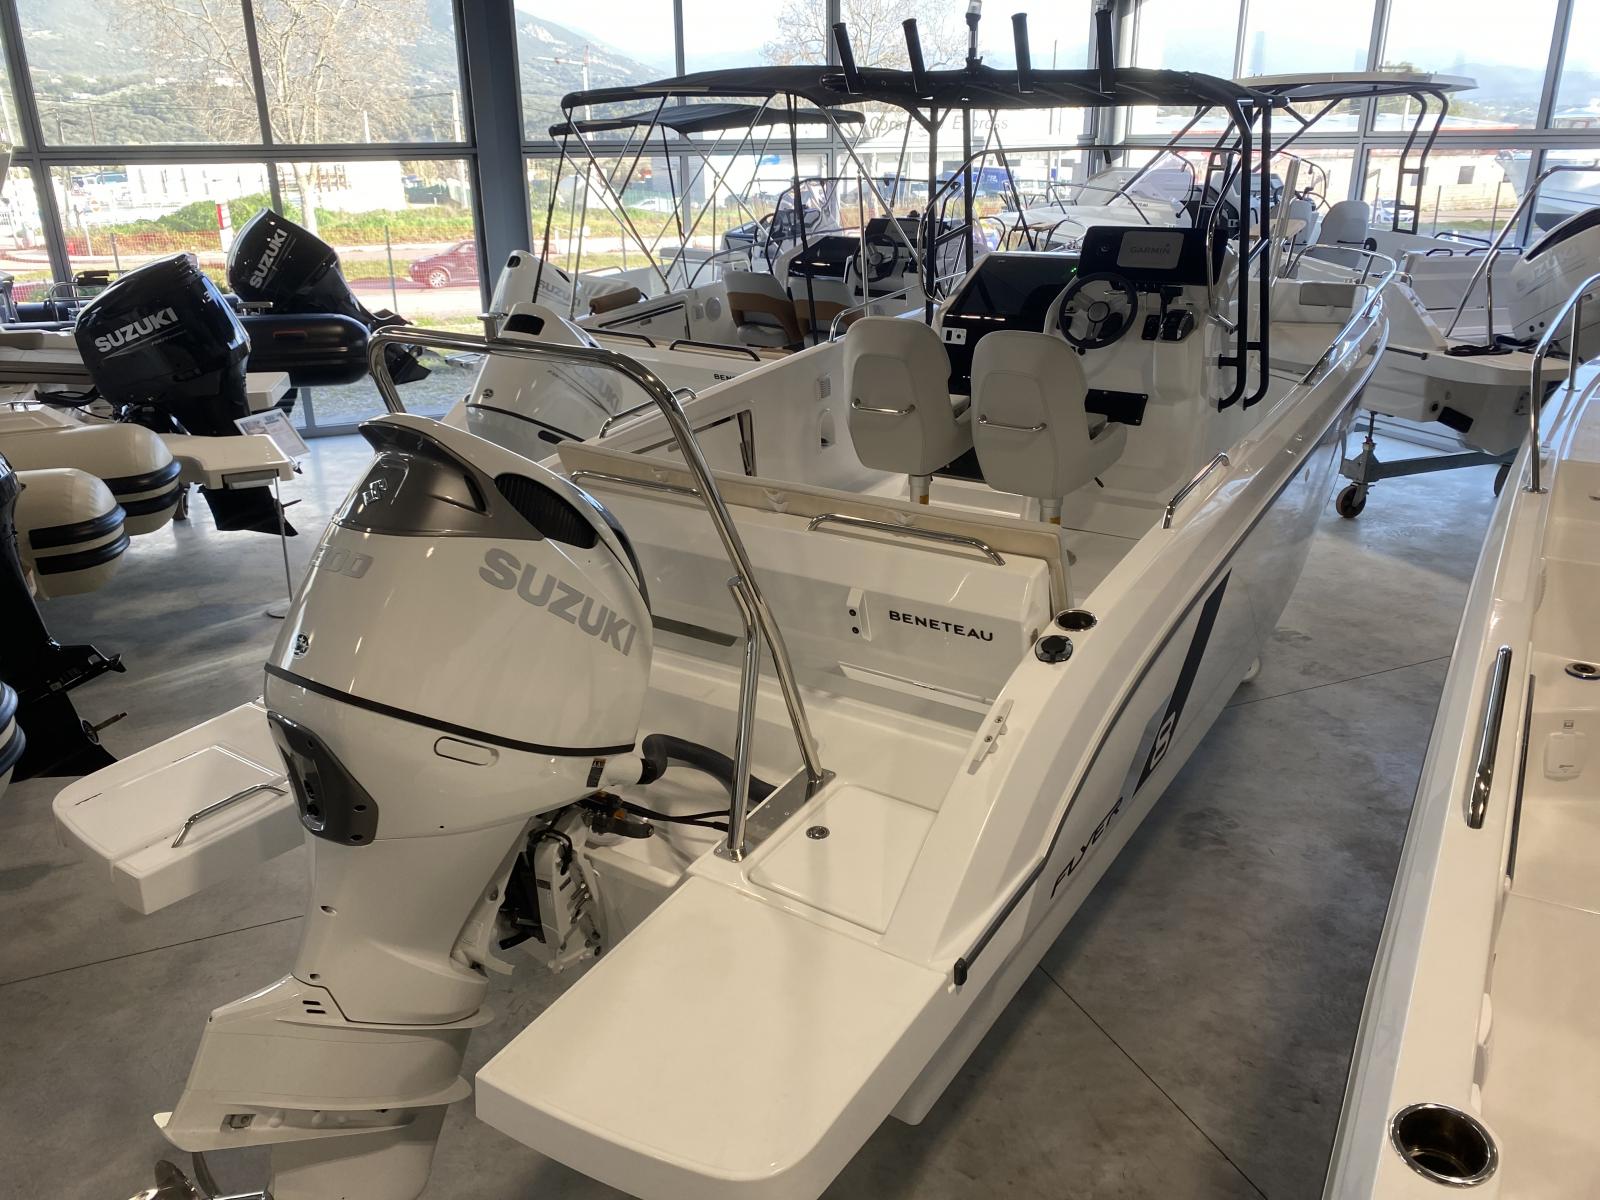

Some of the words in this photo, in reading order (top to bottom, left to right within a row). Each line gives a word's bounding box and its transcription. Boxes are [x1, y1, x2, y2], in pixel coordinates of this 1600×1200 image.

[249, 228, 288, 289] SUZUKI
[1129, 246, 1171, 255] GARMIN
[94, 306, 179, 353] SUZUKI
[478, 547, 637, 657] SUZUKI
[888, 609, 993, 642] BENETEAU
[1050, 796, 1123, 900] FLYER
